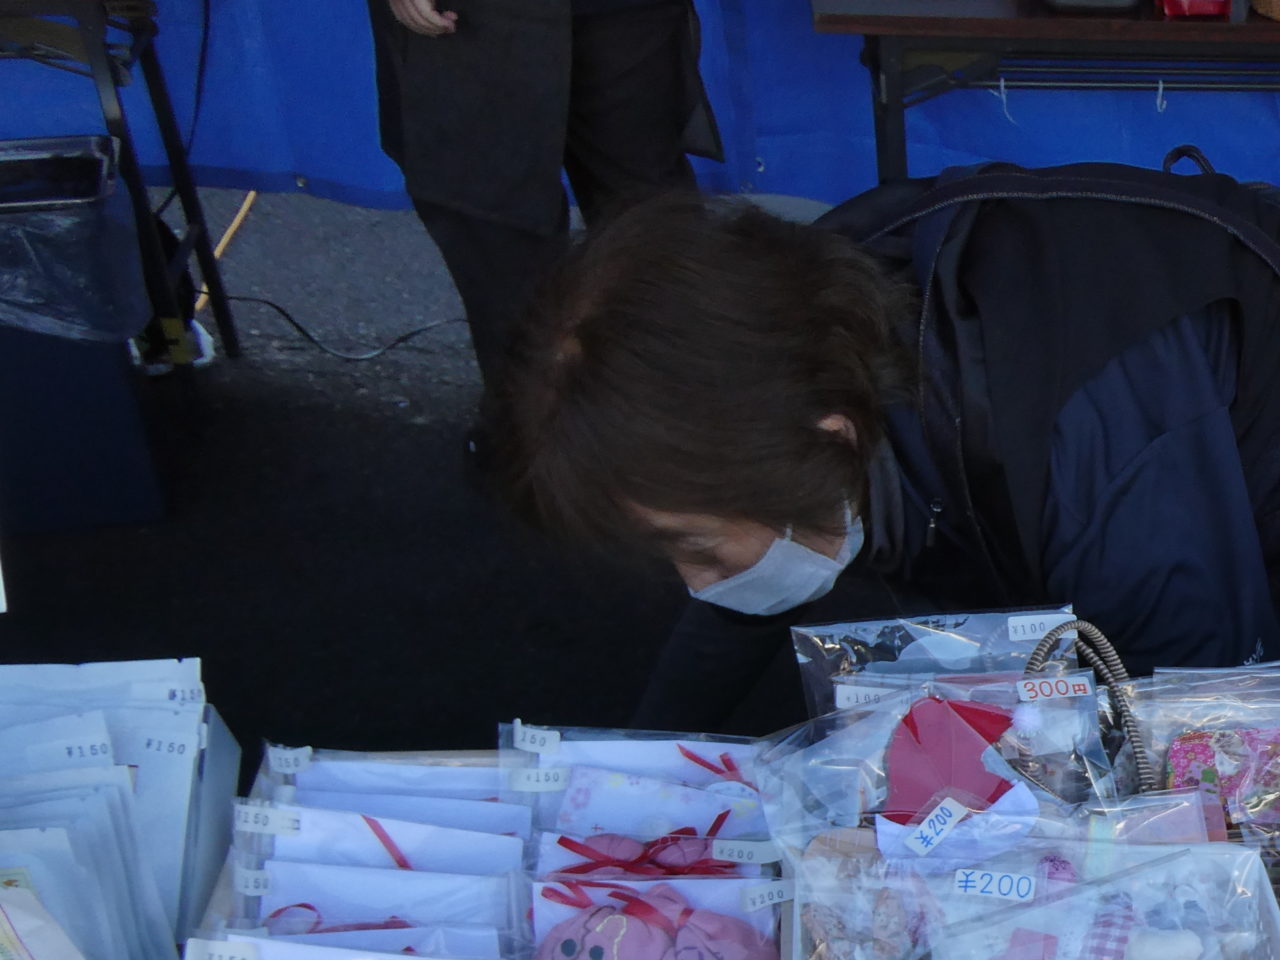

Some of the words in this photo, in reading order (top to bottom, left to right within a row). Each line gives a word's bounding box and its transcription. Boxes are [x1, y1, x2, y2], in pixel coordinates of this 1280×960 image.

[1011, 621, 1046, 635] ¥100
[1023, 679, 1089, 699] 300円
[65, 742, 109, 759] ¥150
[914, 805, 954, 849] ¥200
[957, 870, 1032, 899] ¥200
